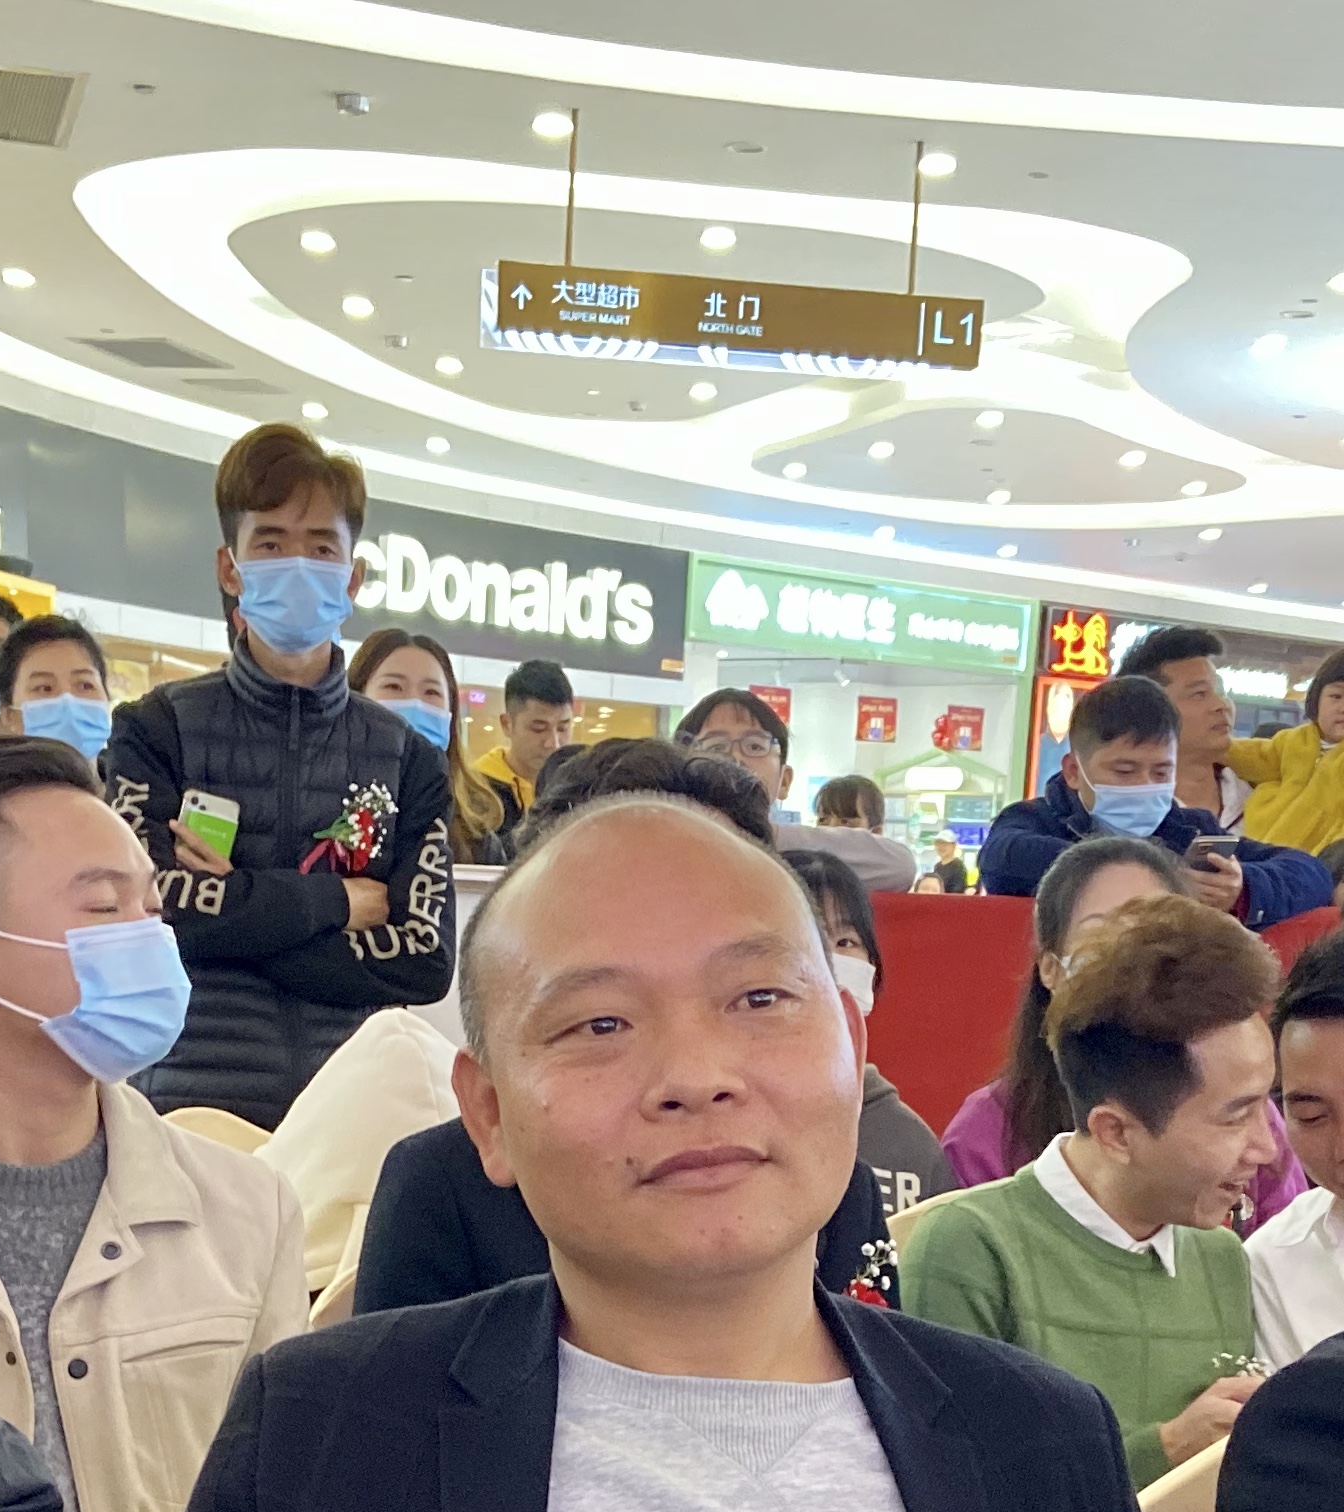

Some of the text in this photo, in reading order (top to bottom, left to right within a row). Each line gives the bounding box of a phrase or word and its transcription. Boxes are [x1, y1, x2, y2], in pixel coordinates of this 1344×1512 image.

[551, 279, 641, 310] 大型超市
[704, 292, 761, 321] 北门
[559, 310, 631, 326] SUPER MART
[697, 321, 763, 337] NORTH GATE
[933, 308, 974, 346] L1
[352, 533, 654, 645] cDonald's
